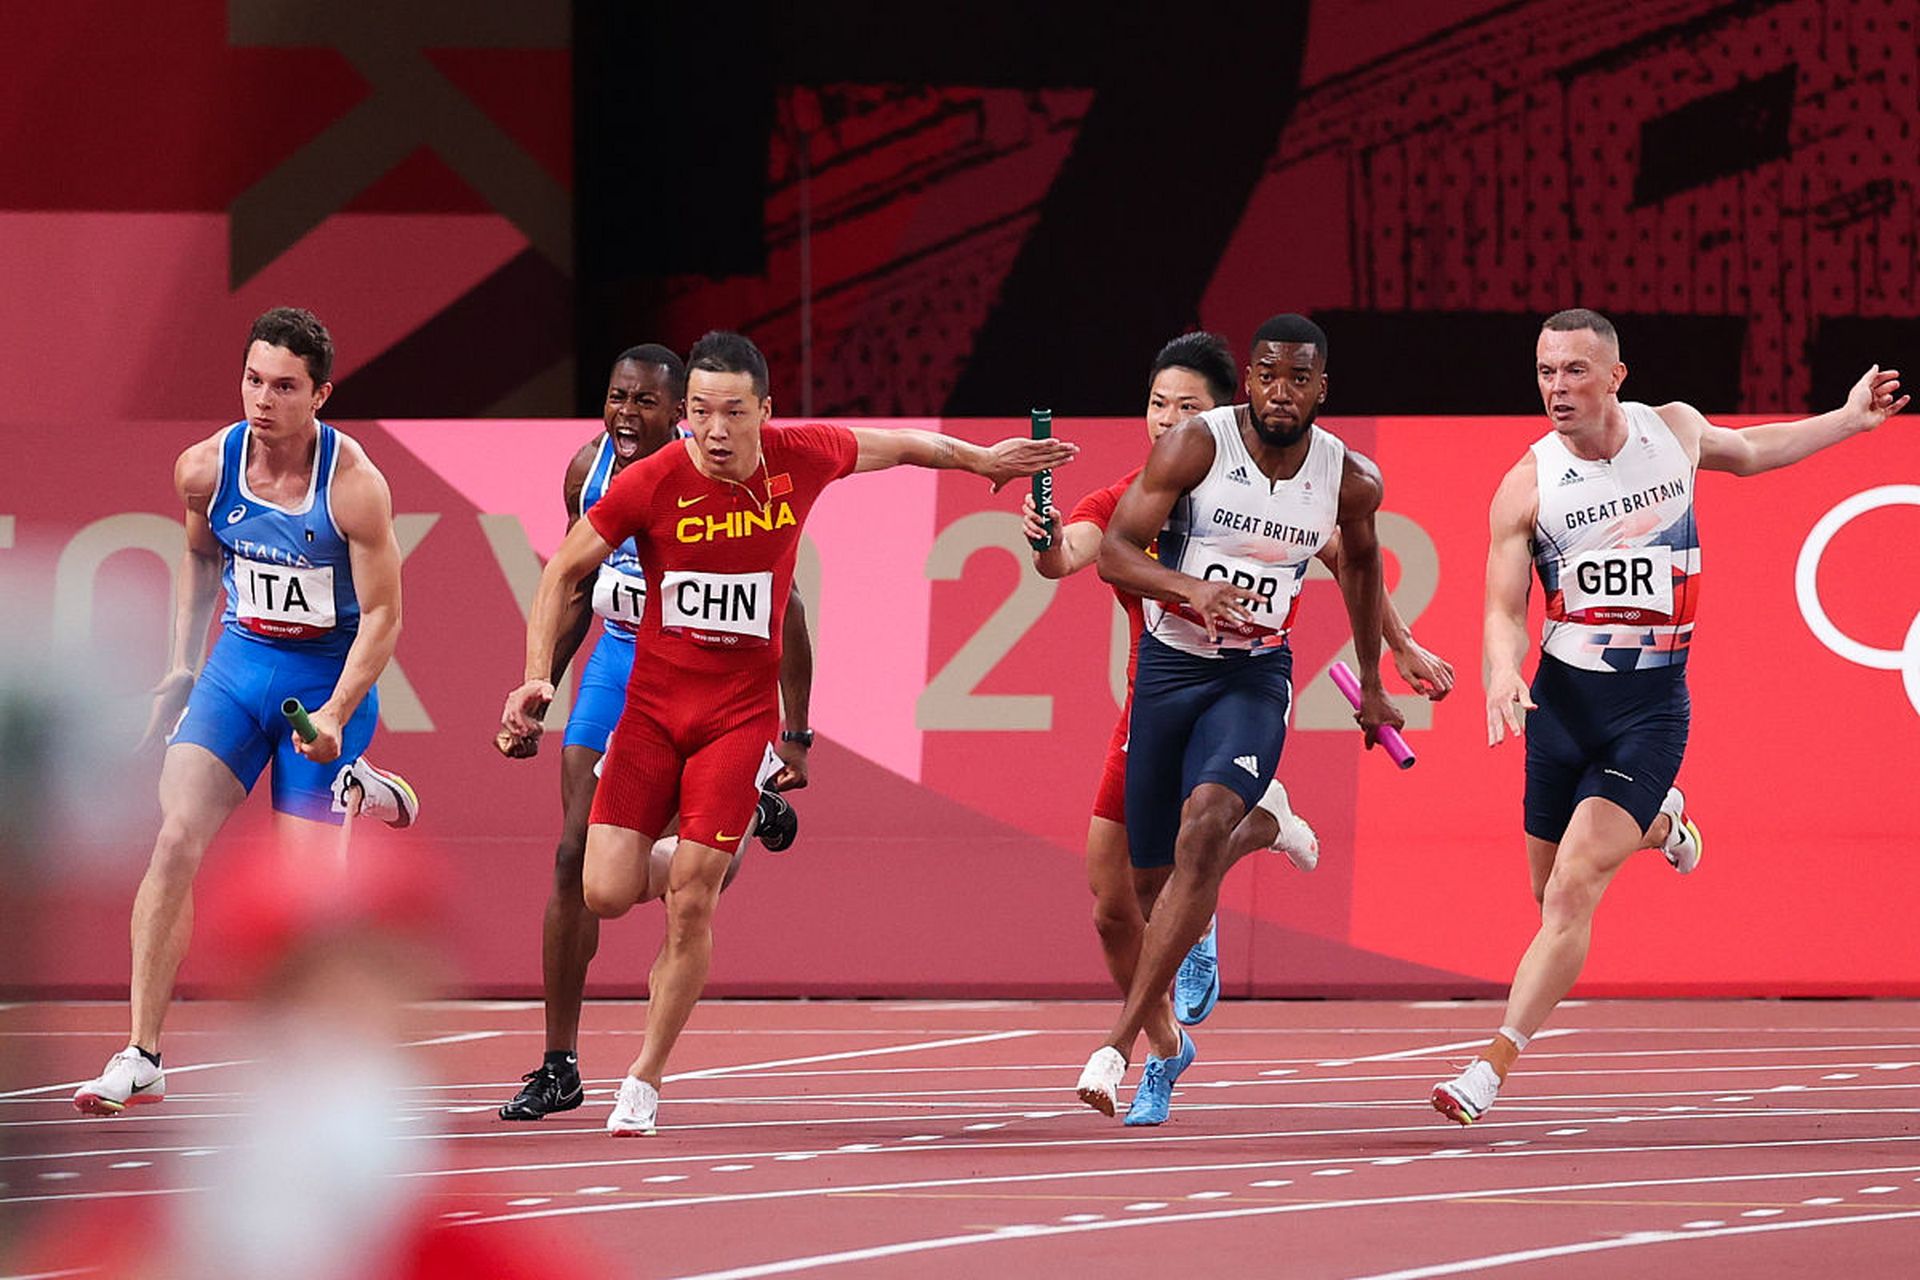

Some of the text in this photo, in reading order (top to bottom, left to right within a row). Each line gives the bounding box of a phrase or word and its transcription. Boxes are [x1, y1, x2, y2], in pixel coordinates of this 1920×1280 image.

[676, 502, 798, 544] CHINA
[1565, 478, 1686, 530] GREAT BRITAIN
[1212, 507, 1320, 547] GREAT BRITAIN
[234, 538, 315, 569] ITALIA
[250, 569, 310, 612] ITA
[1576, 557, 1655, 597] GBR
[612, 581, 647, 618] IT
[676, 580, 758, 622] CHN
